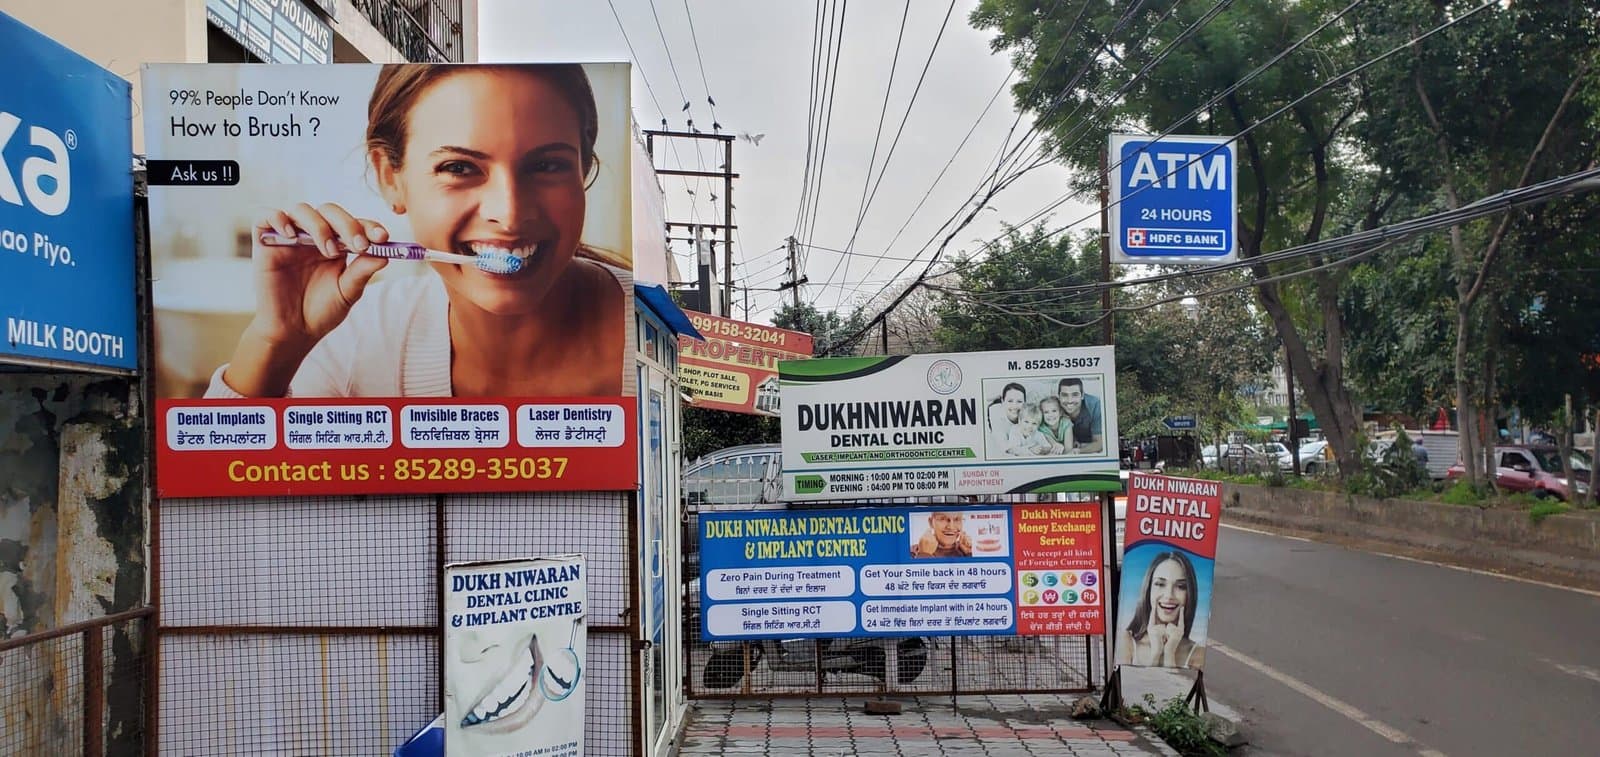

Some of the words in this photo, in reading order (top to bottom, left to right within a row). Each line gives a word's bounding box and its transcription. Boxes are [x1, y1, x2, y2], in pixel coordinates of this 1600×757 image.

[281, 0, 329, 50] HOLIDAYS
[169, 89, 202, 106] 99%
[206, 88, 253, 110] People
[258, 90, 296, 106] Don't
[300, 90, 340, 106] Know
[171, 116, 217, 137] How
[223, 119, 241, 137] to
[249, 113, 301, 137] Brush
[309, 117, 321, 137] ?
[170, 164, 198, 181] Ask
[202, 170, 218, 181] us
[223, 165, 232, 181] !!
[1128, 152, 1226, 190] ATM
[1141, 209, 1157, 220] 24
[1161, 209, 1212, 222] HOURS
[1150, 234, 1182, 243] HDFC
[1185, 235, 1218, 245] BANK
[0, 229, 28, 253] ao
[34, 232, 76, 267] Piyo.
[8, 317, 57, 350] MILK
[63, 327, 124, 359] BOOTH
[1008, 361, 1021, 371] M.
[1025, 357, 1102, 370] 85289-35037
[703, 371, 719, 380] PLOT
[711, 381, 740, 391] SERVICES
[705, 390, 723, 398] BASIS
[177, 412, 213, 426] Dental
[217, 412, 266, 427] Implants
[288, 411, 324, 426] Single
[327, 410, 362, 426] Sitting
[366, 411, 388, 424] RCT
[410, 409, 457, 422] Invisible
[460, 409, 499, 422] Braces
[529, 408, 560, 421] Laser
[563, 407, 612, 423] Dentistry
[797, 398, 977, 431] DUKHNIWARAN
[535, 426, 560, 440] ਲੇਜਰ
[830, 433, 889, 448] DENTAL
[896, 431, 945, 446] CLINIC
[837, 453, 867, 461] IMPLANT
[869, 452, 885, 460] AND
[885, 451, 938, 459] ORTHODONTIC
[938, 449, 966, 457] CENTRE
[228, 460, 332, 482] Contact
[340, 463, 370, 481] us
[379, 465, 385, 480] :
[394, 457, 569, 481] 85289-35037
[830, 474, 865, 482] MORNING
[871, 473, 890, 481] 10:00
[892, 472, 903, 481] AM
[905, 472, 915, 480] TO
[916, 472, 936, 480] 02:00
[937, 471, 949, 479] PM
[958, 478, 1004, 487] APPOINTMENT
[797, 480, 824, 489] TIMING
[830, 484, 863, 493] EVENING
[871, 483, 890, 491] 04:00
[892, 483, 903, 491] PM
[905, 482, 915, 490] TO
[916, 482, 937, 490] 08:00
[937, 481, 949, 489] PM
[1134, 477, 1164, 491] DUKH
[1168, 480, 1217, 496] NIWARAN
[1136, 495, 1211, 518] DENTAL
[1021, 510, 1048, 520] Dukh
[1050, 509, 1092, 519] Niwaran
[706, 519, 743, 538] DUKH
[745, 518, 806, 537] NIWARAN
[809, 517, 860, 535] DENTAL
[862, 515, 905, 534] CLINIC
[1018, 523, 1049, 534] Money
[1051, 522, 1096, 534] Exchange
[1140, 518, 1205, 540] CLINIC
[1040, 536, 1076, 546] Service
[745, 543, 754, 559] &
[758, 539, 814, 559] IMPLANT
[816, 539, 867, 557] CENTRE
[1022, 550, 1035, 558] We
[1037, 550, 1061, 559] accept
[1063, 549, 1073, 557] all
[1075, 549, 1093, 557] kind
[1029, 559, 1058, 568] Foreign
[1060, 559, 1097, 568] Currency
[452, 573, 501, 592] DUKH
[505, 565, 581, 588] NIWARAN
[720, 573, 740, 582] Zero
[743, 572, 762, 581] Pain
[765, 572, 794, 581] During
[797, 570, 841, 580] Treatment
[864, 569, 880, 578] Get
[882, 569, 903, 578] Your
[905, 568, 931, 578] Smile
[932, 568, 954, 577] back
[956, 568, 966, 577] in
[967, 567, 978, 576] 48
[980, 567, 1007, 576] hours
[885, 583, 895, 591] 48
[467, 592, 522, 609] DENTAL
[524, 586, 569, 603] CLINIC
[451, 615, 463, 627] &
[466, 609, 527, 627] IMPLANT
[530, 602, 582, 618] CENTRE
[741, 607, 769, 618] Single
[771, 606, 800, 617] Sitting
[802, 605, 822, 615] RCT
[866, 604, 879, 613] Get
[881, 604, 918, 613] Immediate
[920, 603, 948, 614] Implant
[949, 603, 965, 611] with
[966, 603, 974, 611] in
[975, 603, 985, 611] 24
[986, 602, 1008, 611] hours
[866, 619, 877, 628] 24
[568, 741, 578, 749] PM
